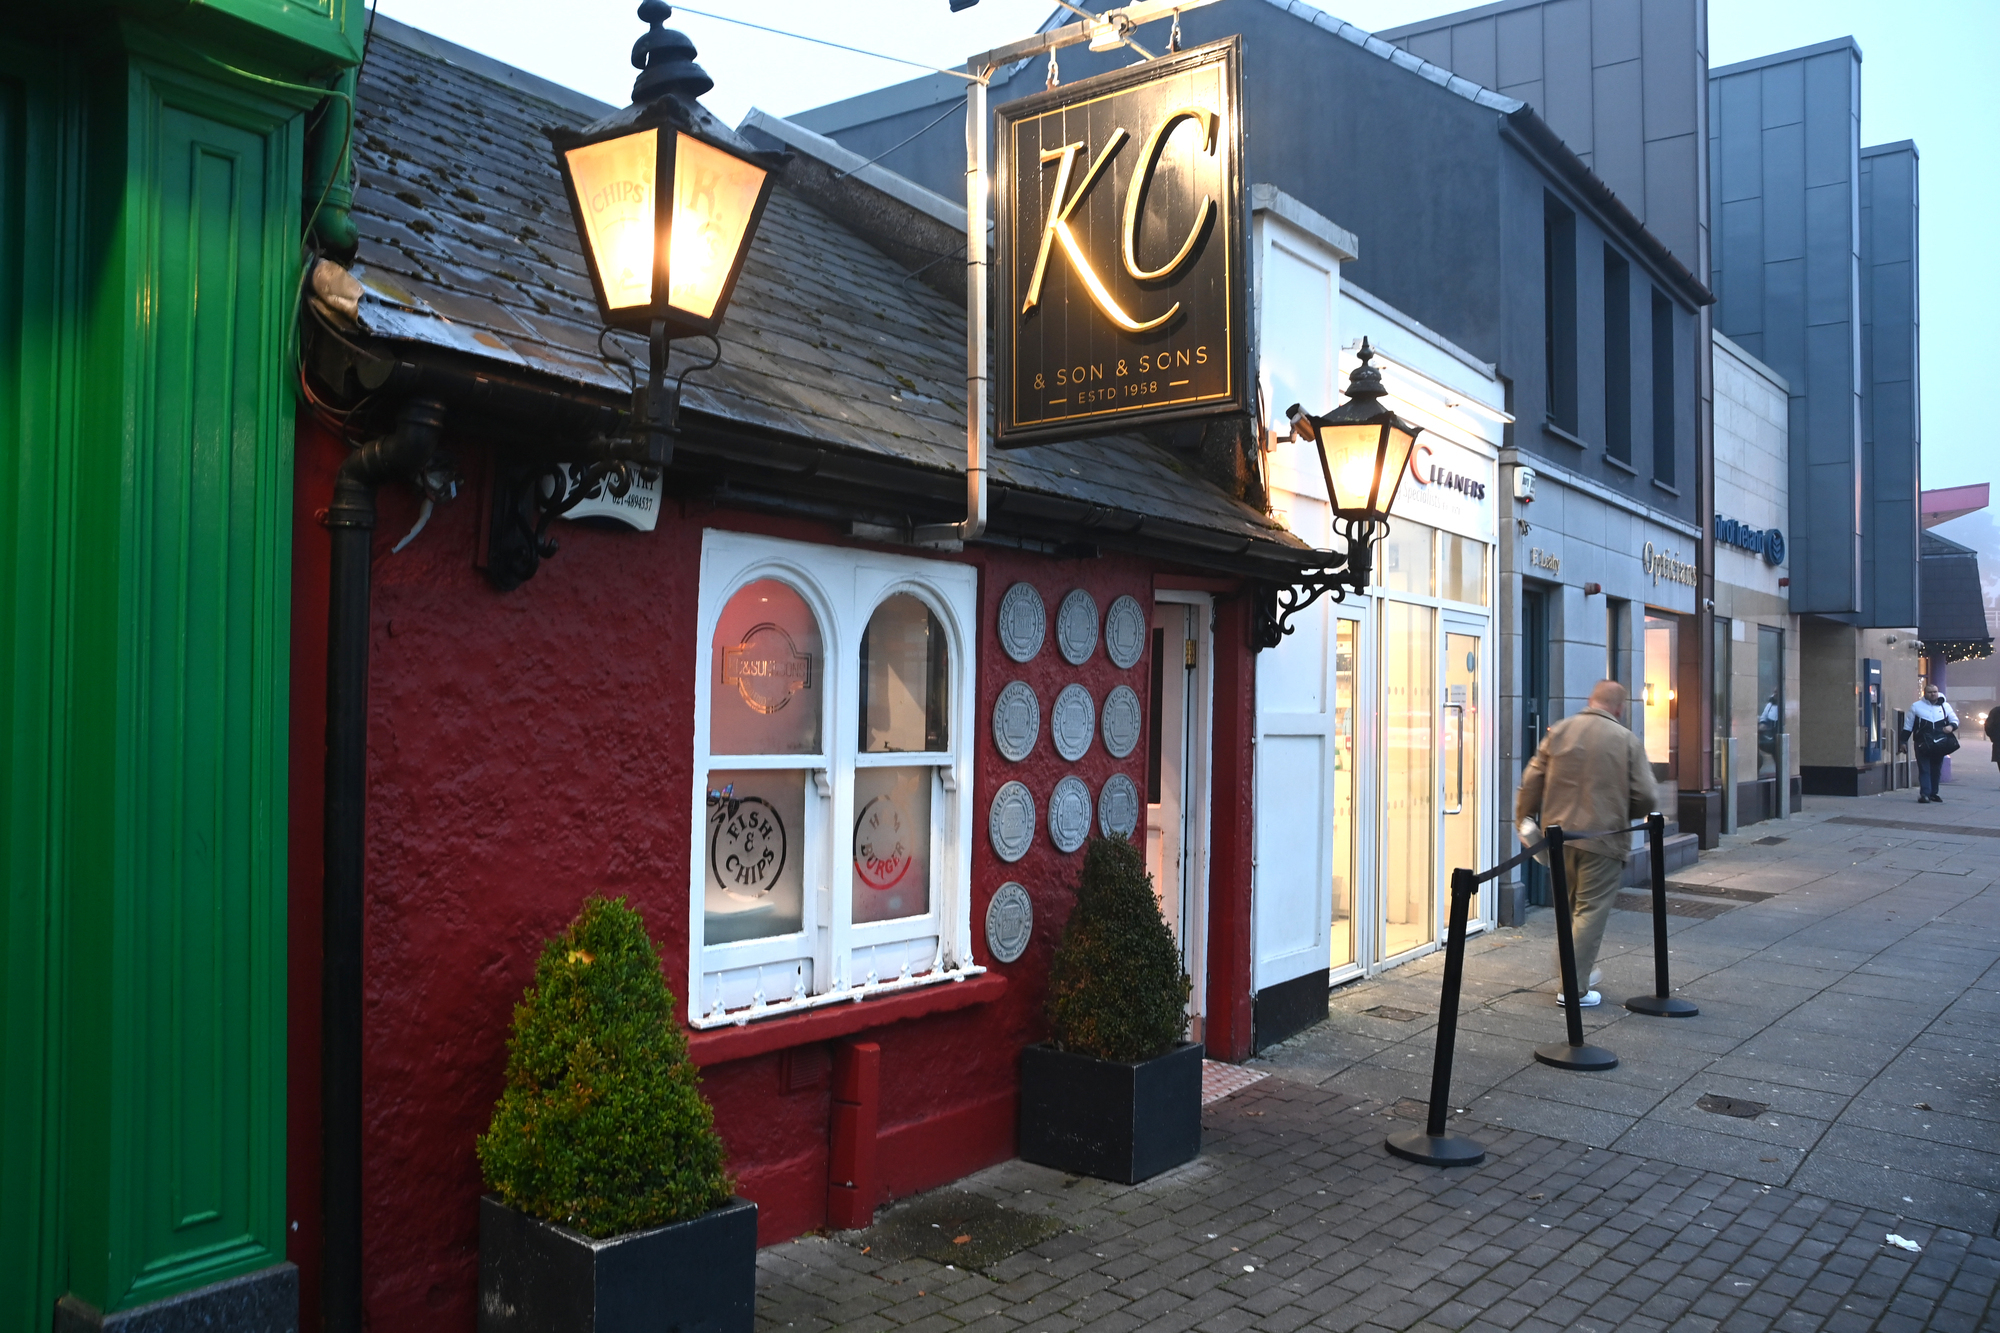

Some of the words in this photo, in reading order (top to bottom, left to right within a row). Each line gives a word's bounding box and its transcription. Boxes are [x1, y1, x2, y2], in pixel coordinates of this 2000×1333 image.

[591, 181, 644, 214] CHIPS
[1022, 107, 1218, 332] KC
[1033, 372, 1046, 390] &
[1056, 362, 1104, 386] SON
[1115, 358, 1129, 377] &
[1139, 345, 1208, 371] SONS
[1077, 387, 1117, 404] ESTD
[1124, 380, 1158, 397] 1958
[1403, 481, 1441, 510] Specialists
[1643, 540, 1697, 587] Opticians
[727, 809, 772, 843] FISH
[743, 831, 755, 852] &
[725, 845, 775, 886] CHIPS
[860, 840, 905, 880] BURGER
